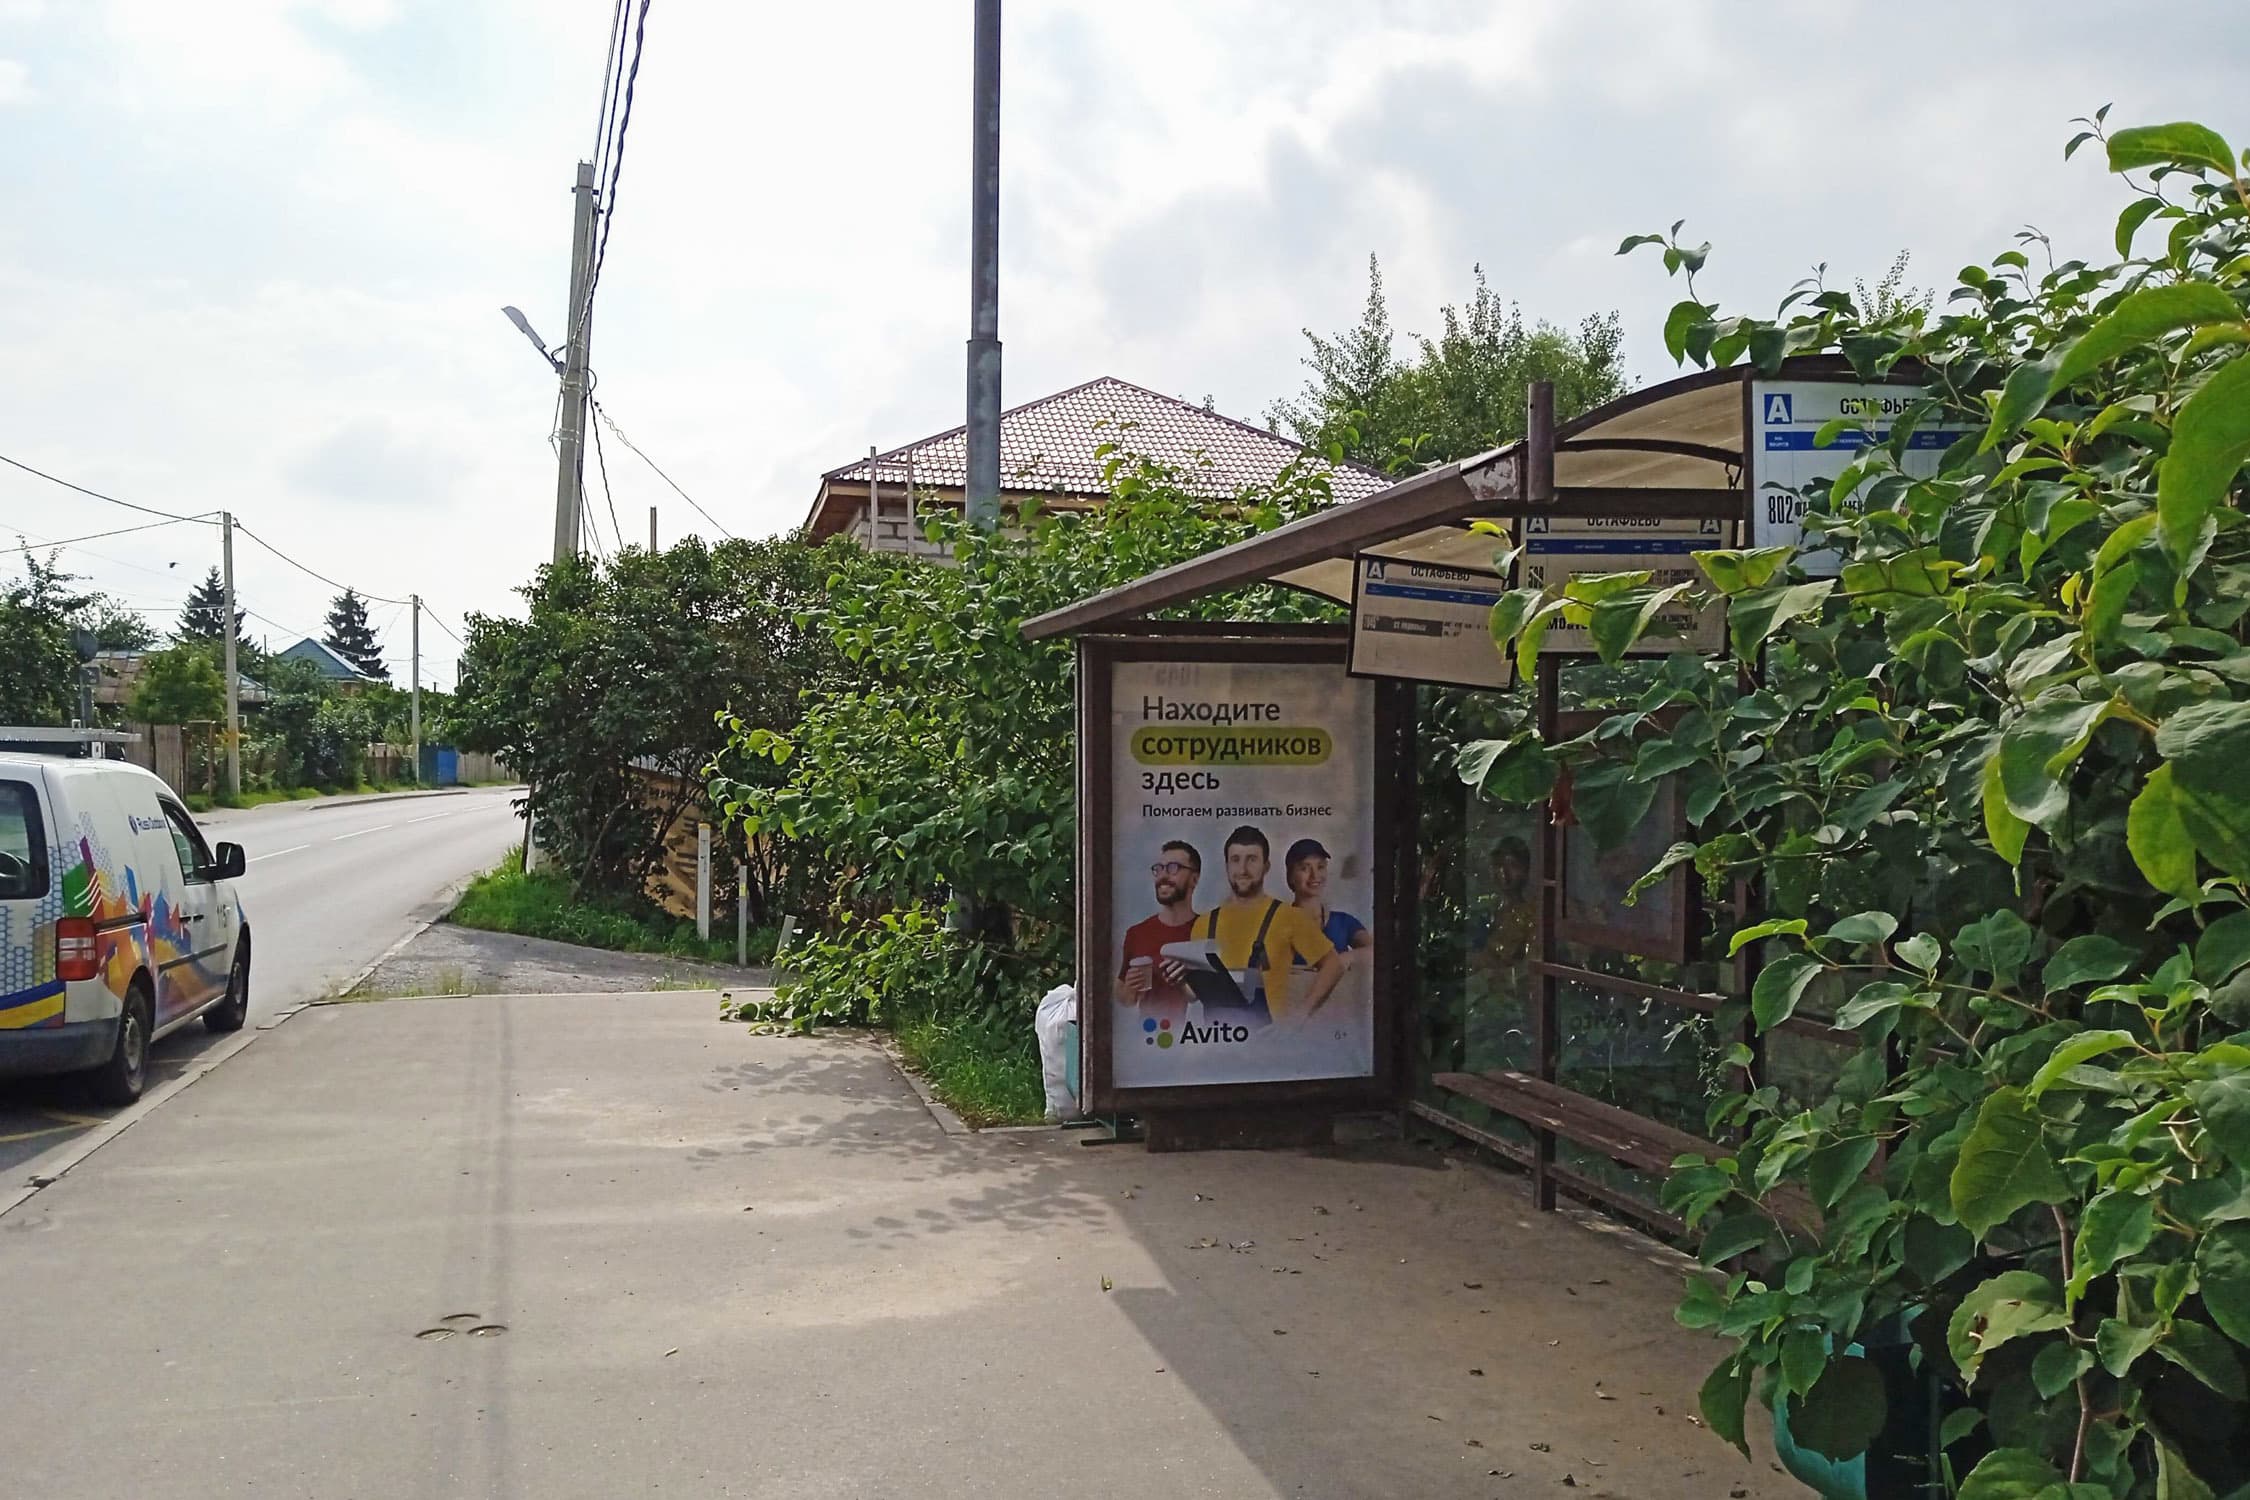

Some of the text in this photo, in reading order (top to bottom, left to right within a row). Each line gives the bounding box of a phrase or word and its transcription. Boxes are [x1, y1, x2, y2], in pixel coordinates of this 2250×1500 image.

[1768, 496, 1793, 524] 802
[1410, 566, 1471, 582] ОСТАФЬЕВО
[1142, 696, 1281, 726] Находите
[1141, 736, 1322, 761] сотрудников
[1141, 771, 1220, 795] здесь
[1143, 802, 1332, 819] Помогаем развивать бизнес
[1179, 1020, 1249, 1045] Avito
